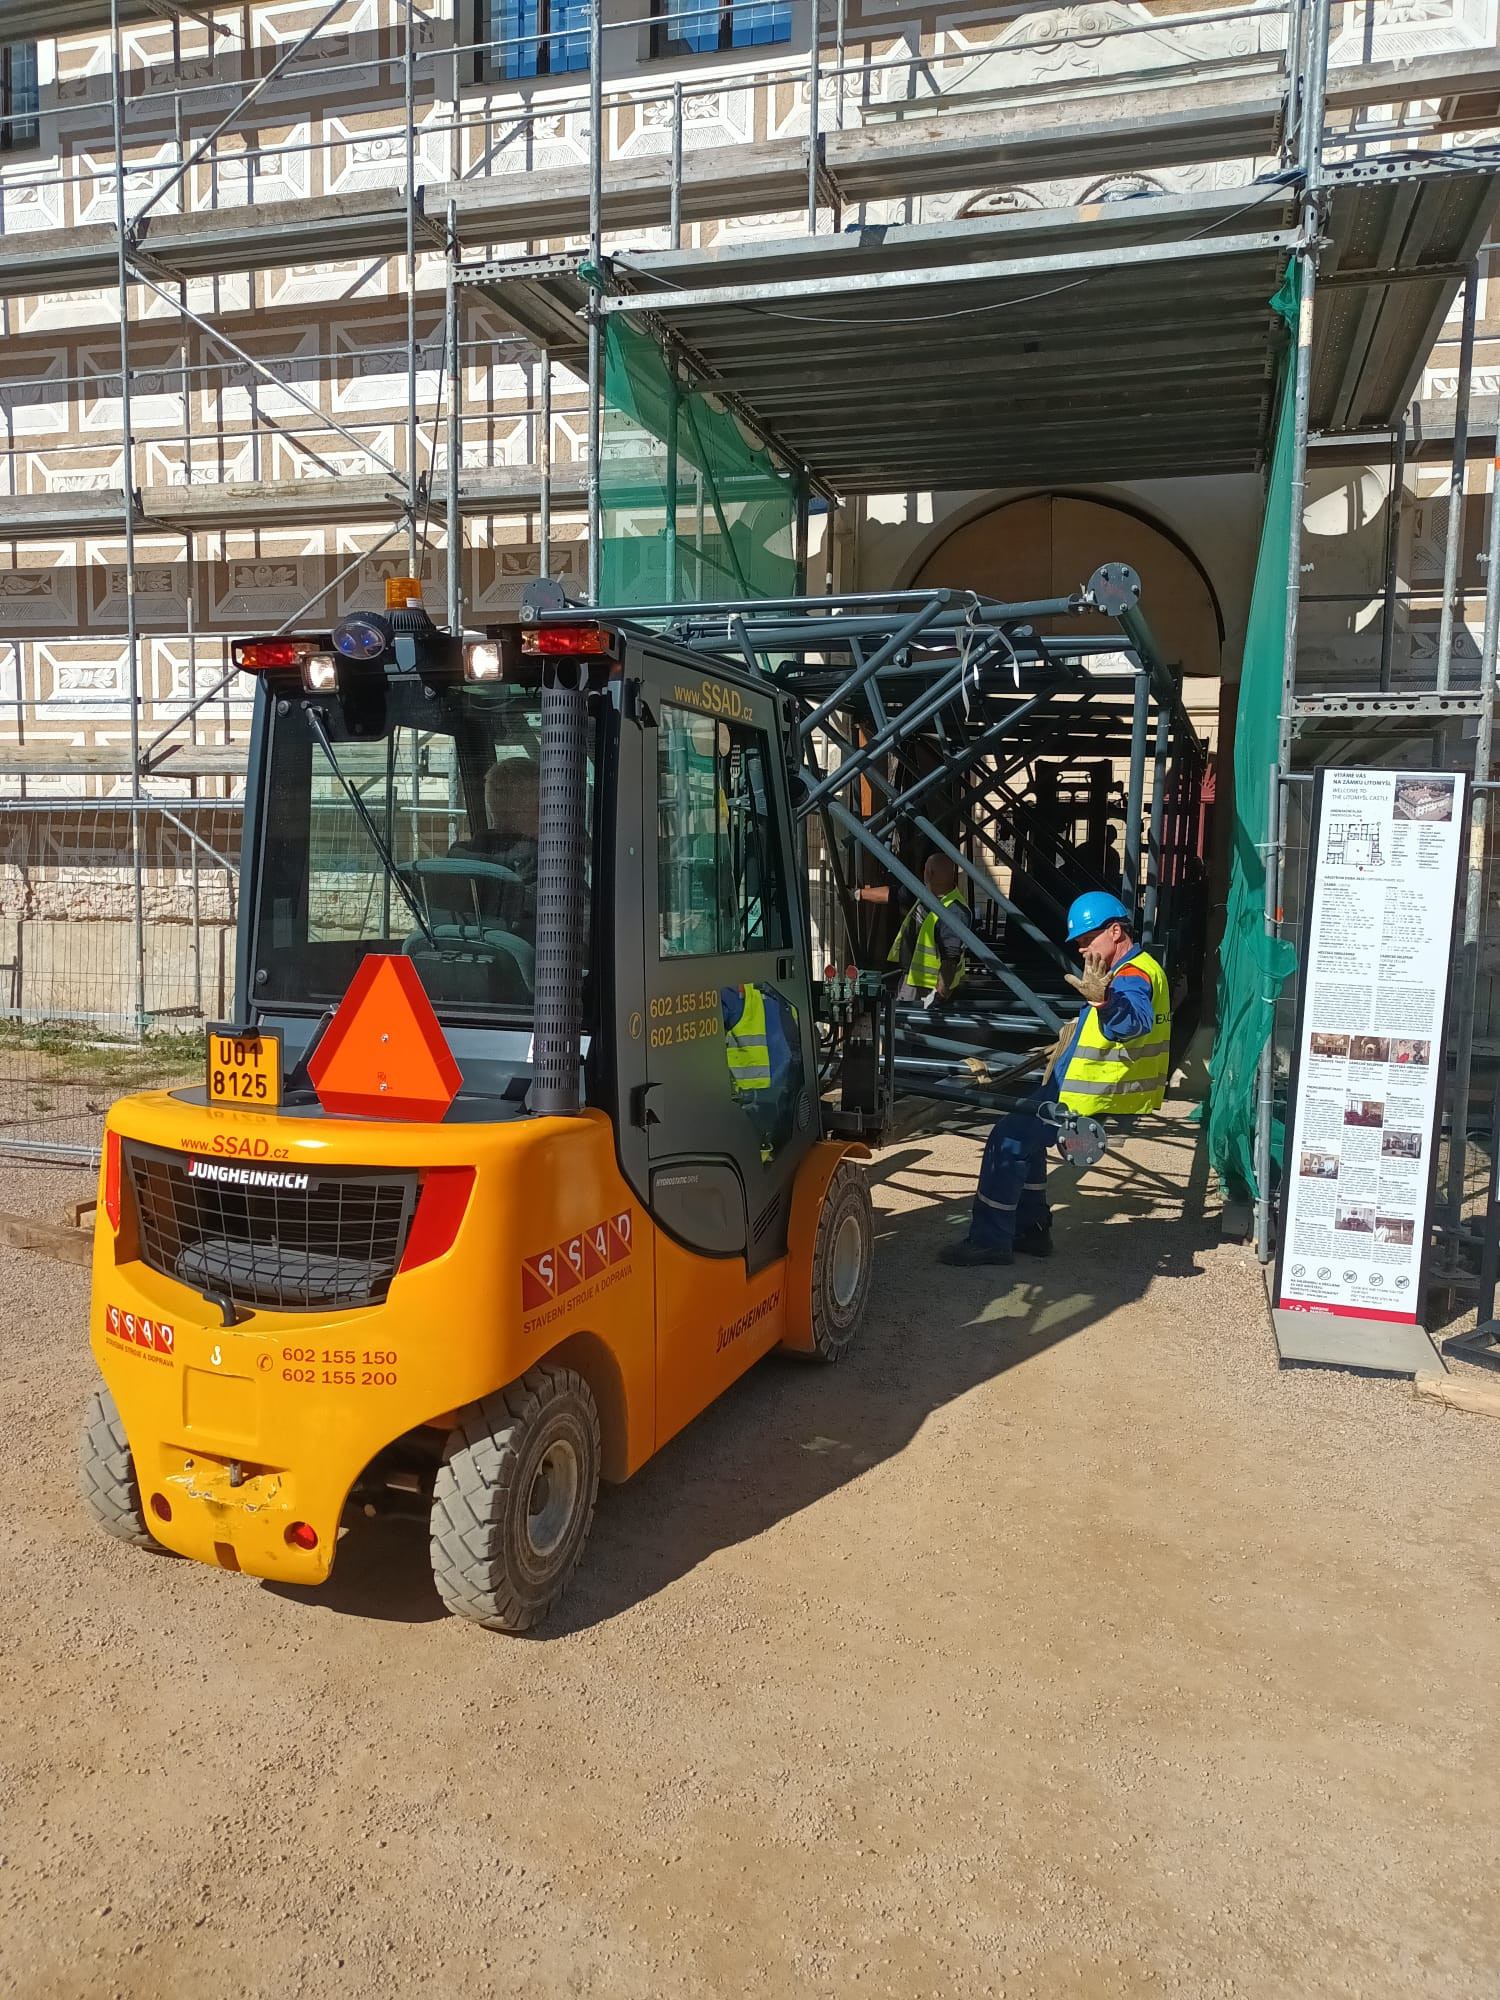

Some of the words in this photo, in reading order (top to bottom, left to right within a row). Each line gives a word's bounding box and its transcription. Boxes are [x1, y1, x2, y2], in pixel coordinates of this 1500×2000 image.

[674, 681, 753, 722] www.SSAD.cz
[650, 996, 673, 1018] 602
[675, 993, 697, 1014] 155
[698, 990, 718, 1010] 150
[650, 1026, 673, 1048] 602
[675, 1021, 697, 1043] 155
[699, 1017, 719, 1038] 200
[213, 1070, 267, 1099] 8125
[181, 1134, 290, 1159] www.SSAD.cz
[188, 1158, 309, 1190] JUNGHEINRICH
[536, 1212, 631, 1290] SSAD
[523, 1302, 566, 1334] STAVEBNÍ
[566, 1286, 595, 1312] STROJE
[594, 1283, 600, 1294] A
[600, 1264, 633, 1291] DOPRAVA
[110, 1306, 173, 1347] SSAD
[715, 1287, 781, 1355] JUNGHEINRICH
[147, 1354, 175, 1368] DOPRAVA
[282, 1347, 316, 1363] 602
[321, 1350, 356, 1364] 155
[361, 1351, 398, 1365] 150
[282, 1368, 316, 1383] 602
[321, 1370, 356, 1385] 155
[361, 1372, 397, 1386] 200
